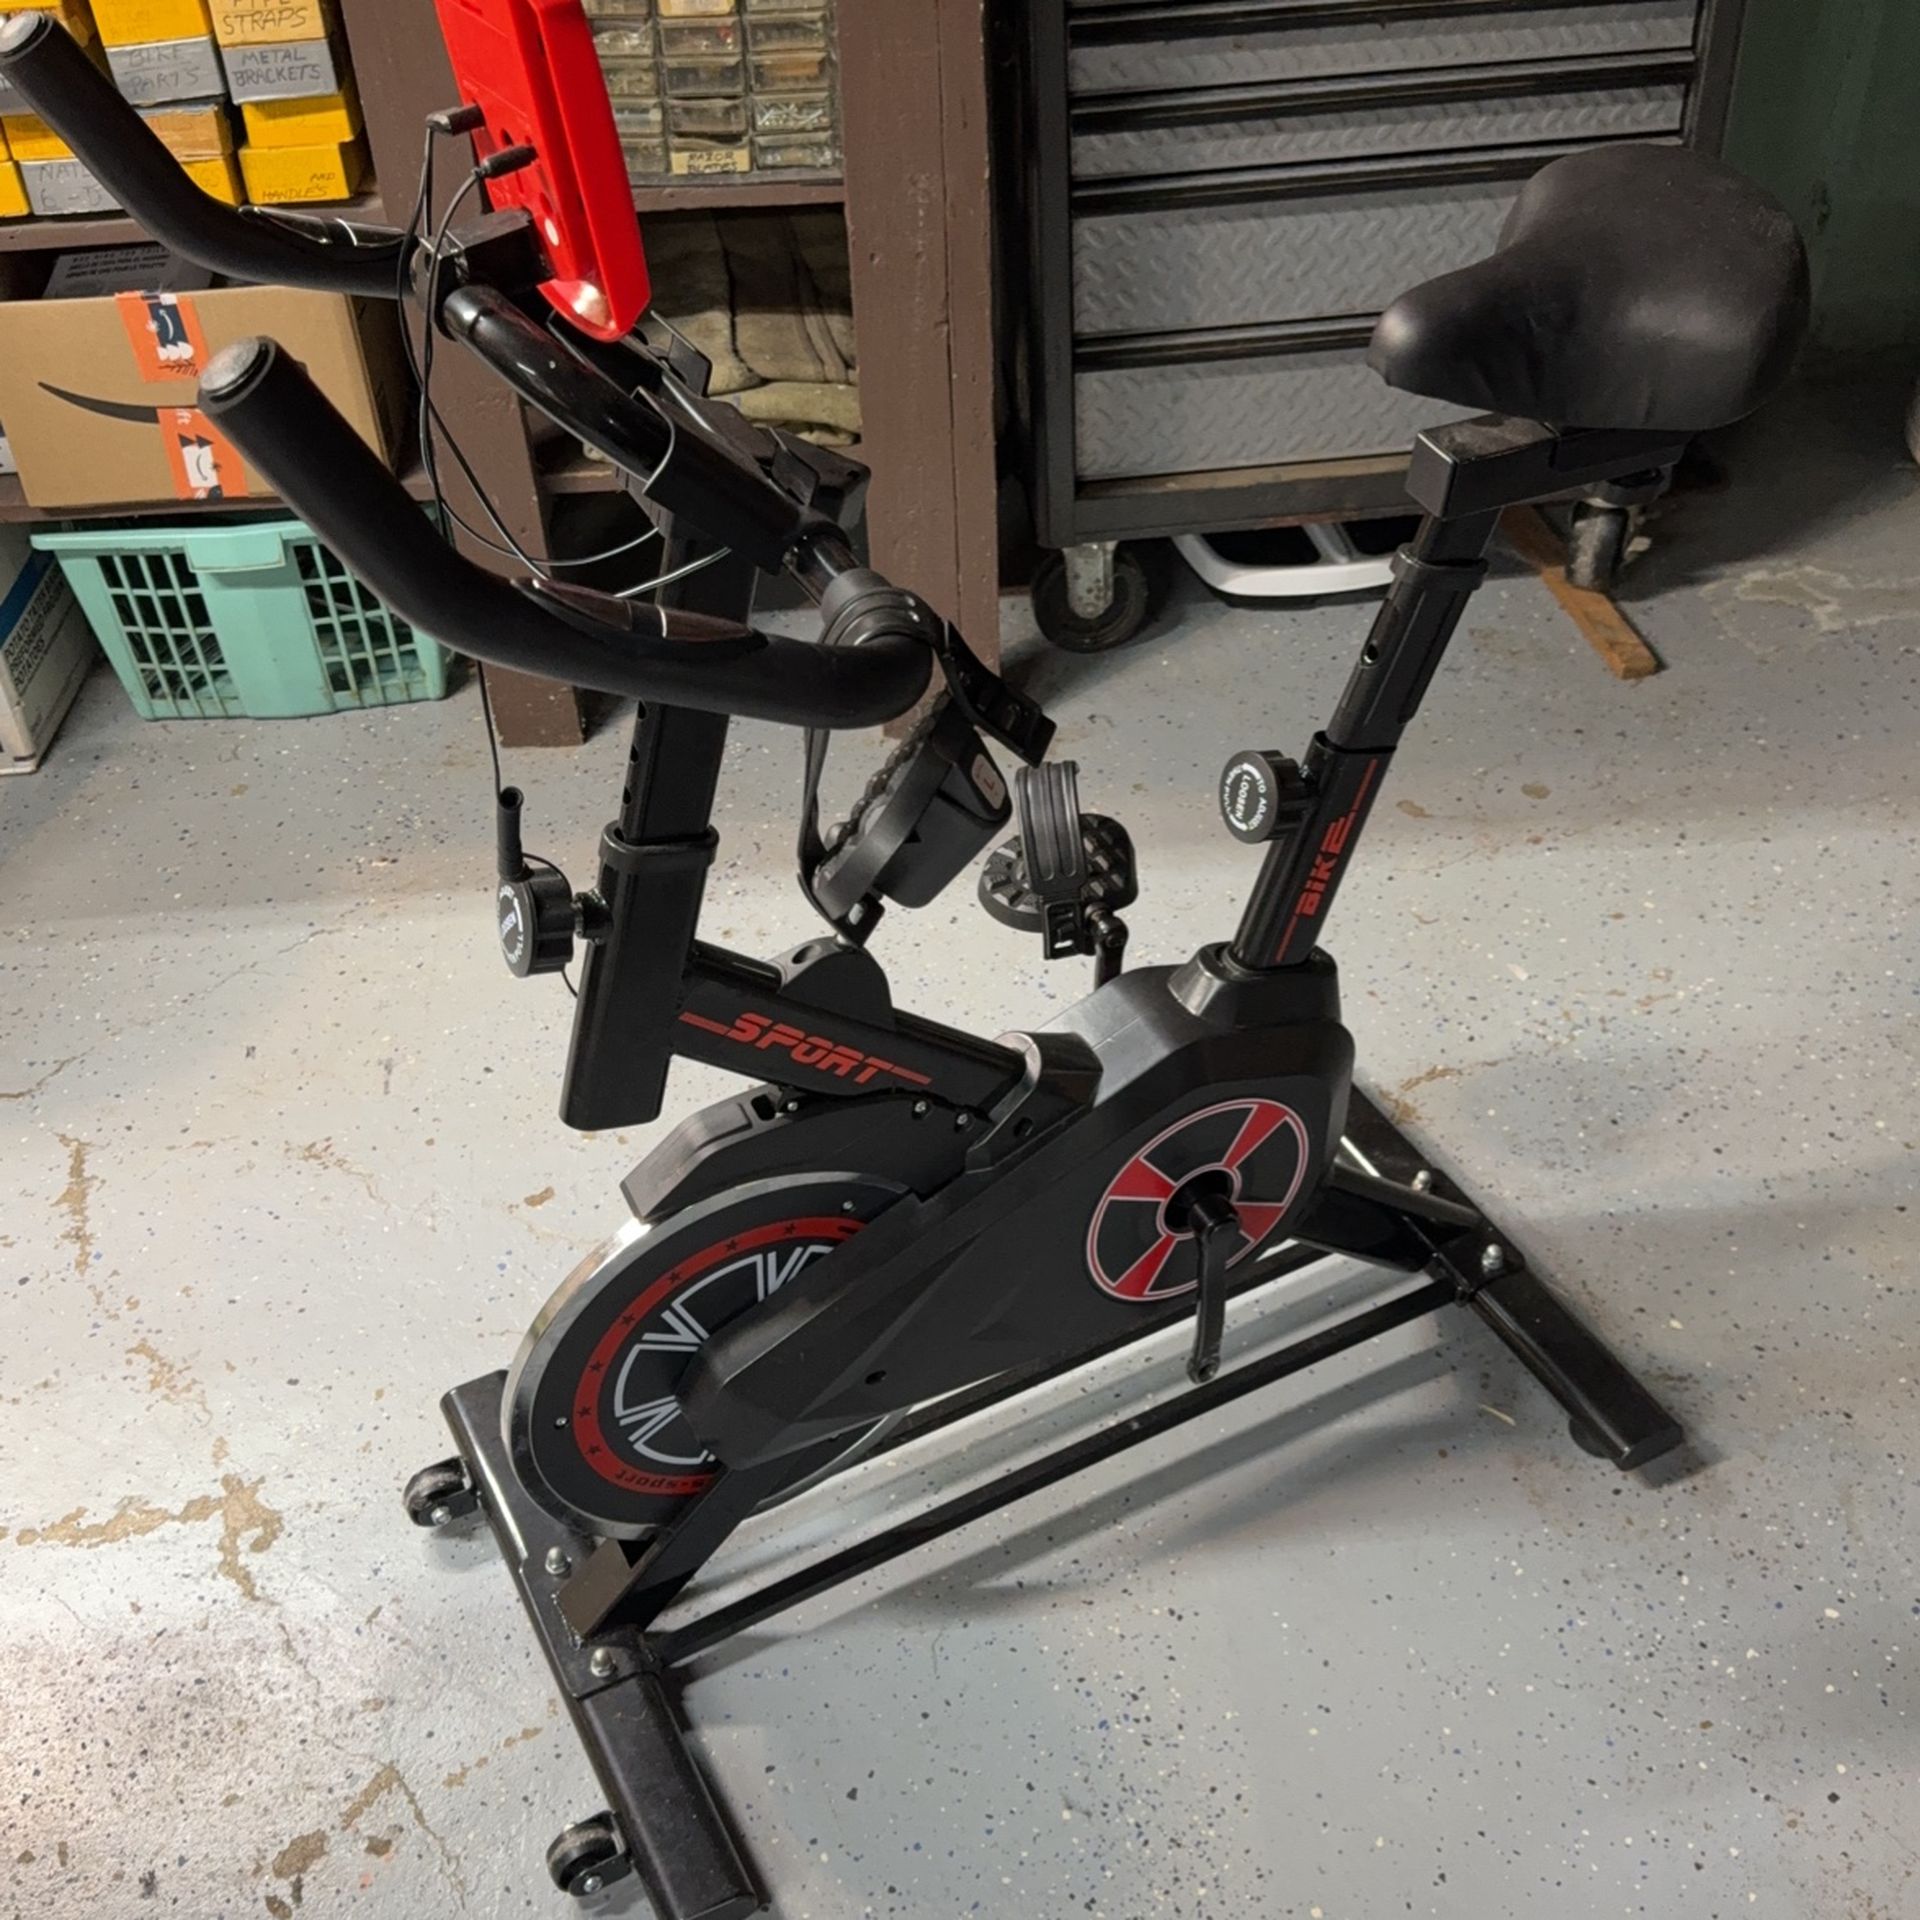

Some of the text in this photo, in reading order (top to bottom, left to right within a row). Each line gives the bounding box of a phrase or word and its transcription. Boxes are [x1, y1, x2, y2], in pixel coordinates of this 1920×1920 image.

[223, 6, 309, 36] STRAPS
[241, 49, 306, 66] METAL
[130, 70, 200, 95] PARTS
[232, 64, 321, 87] BRACKETS
[1235, 774, 1251, 820] LOOSEN
[1295, 811, 1356, 917] BIKE
[726, 1012, 894, 1085] SPORT
